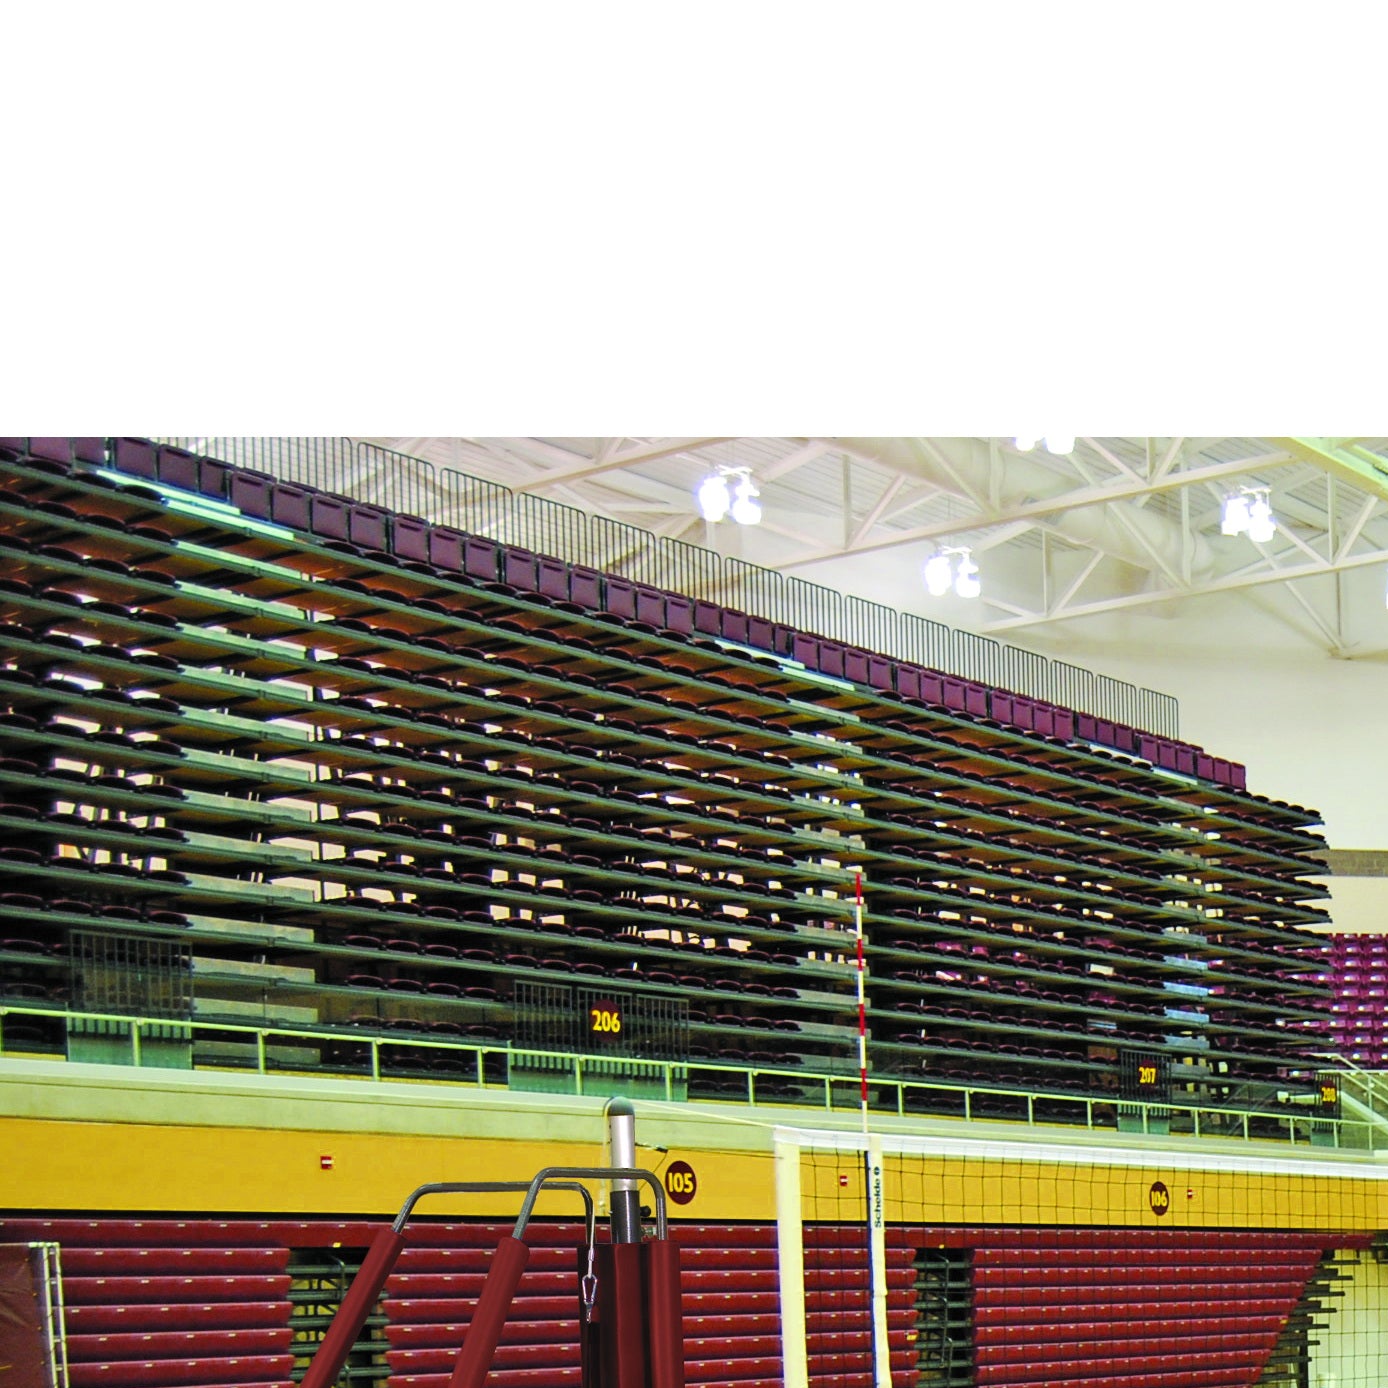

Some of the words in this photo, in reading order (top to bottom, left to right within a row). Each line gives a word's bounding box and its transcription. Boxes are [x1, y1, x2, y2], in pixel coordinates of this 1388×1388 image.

[591, 1009, 621, 1033] 206
[1138, 1066, 1156, 1084] 207
[667, 1172, 694, 1194] 105
[1151, 1191, 1168, 1208] 106
